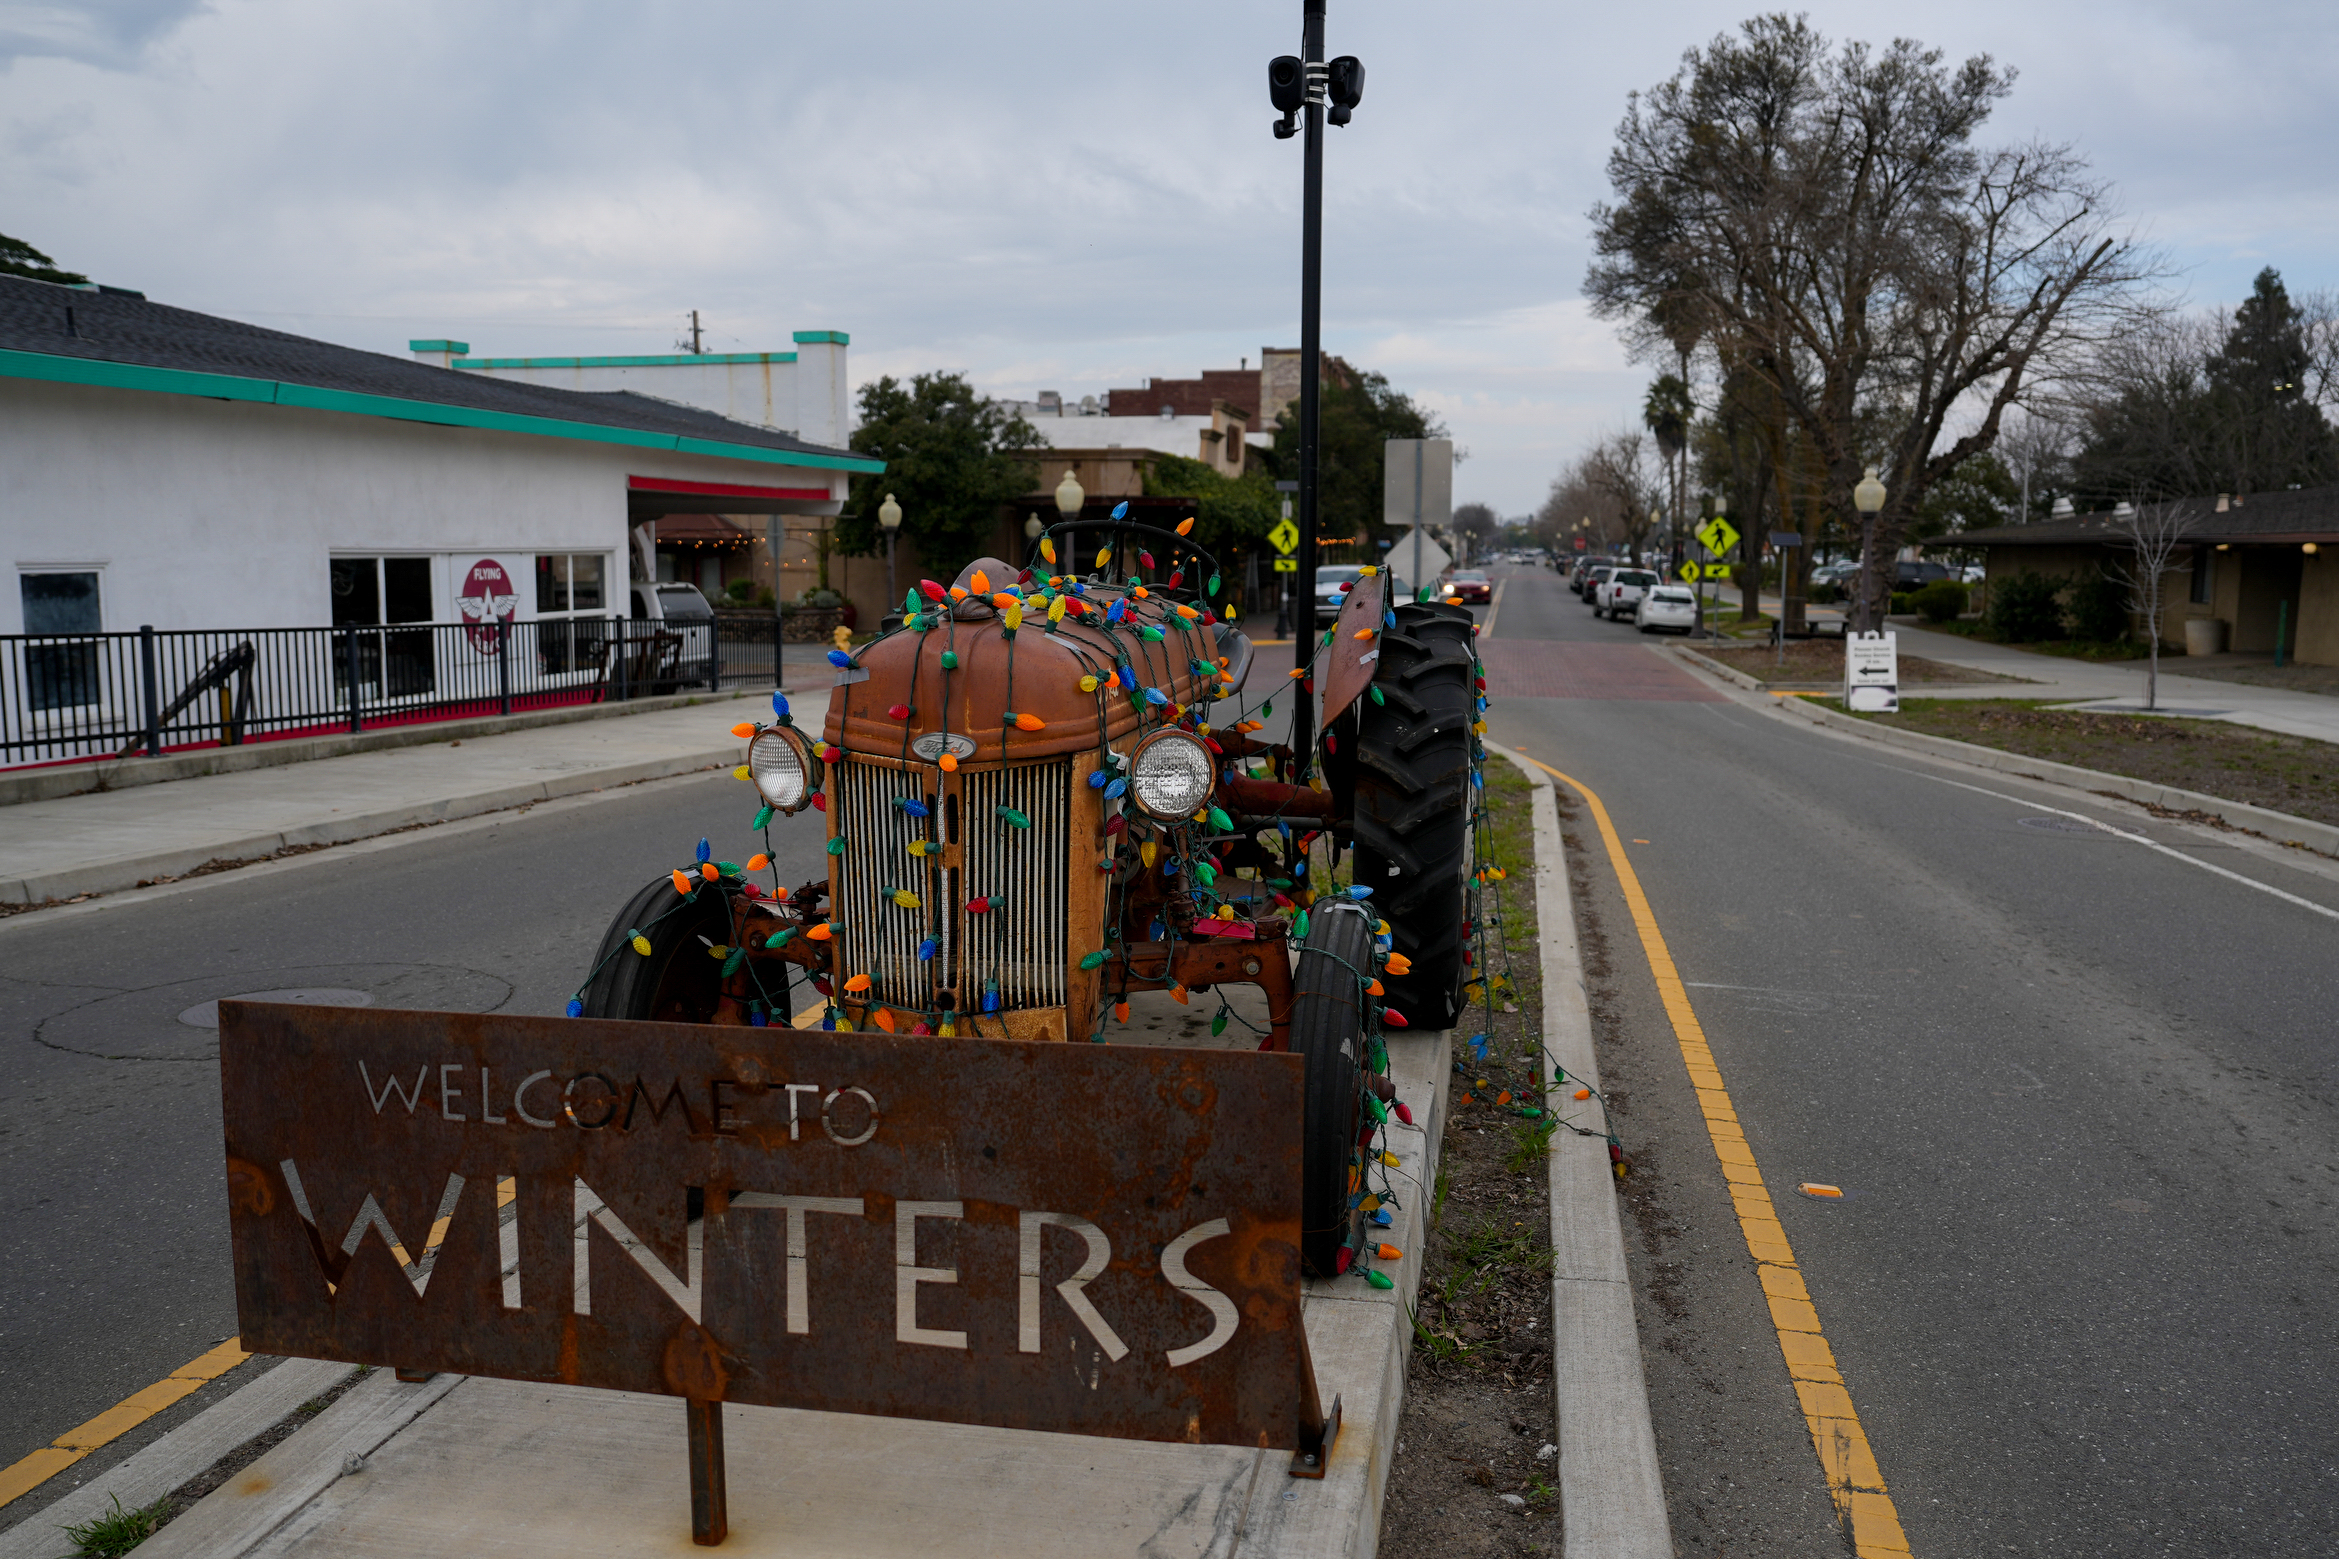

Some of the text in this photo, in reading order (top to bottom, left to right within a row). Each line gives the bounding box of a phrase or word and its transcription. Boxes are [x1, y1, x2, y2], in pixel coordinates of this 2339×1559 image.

[473, 567, 502, 581] FLYING
[357, 1058, 880, 1147] WELCOME TO
[279, 1157, 1241, 1368] WINTERS
